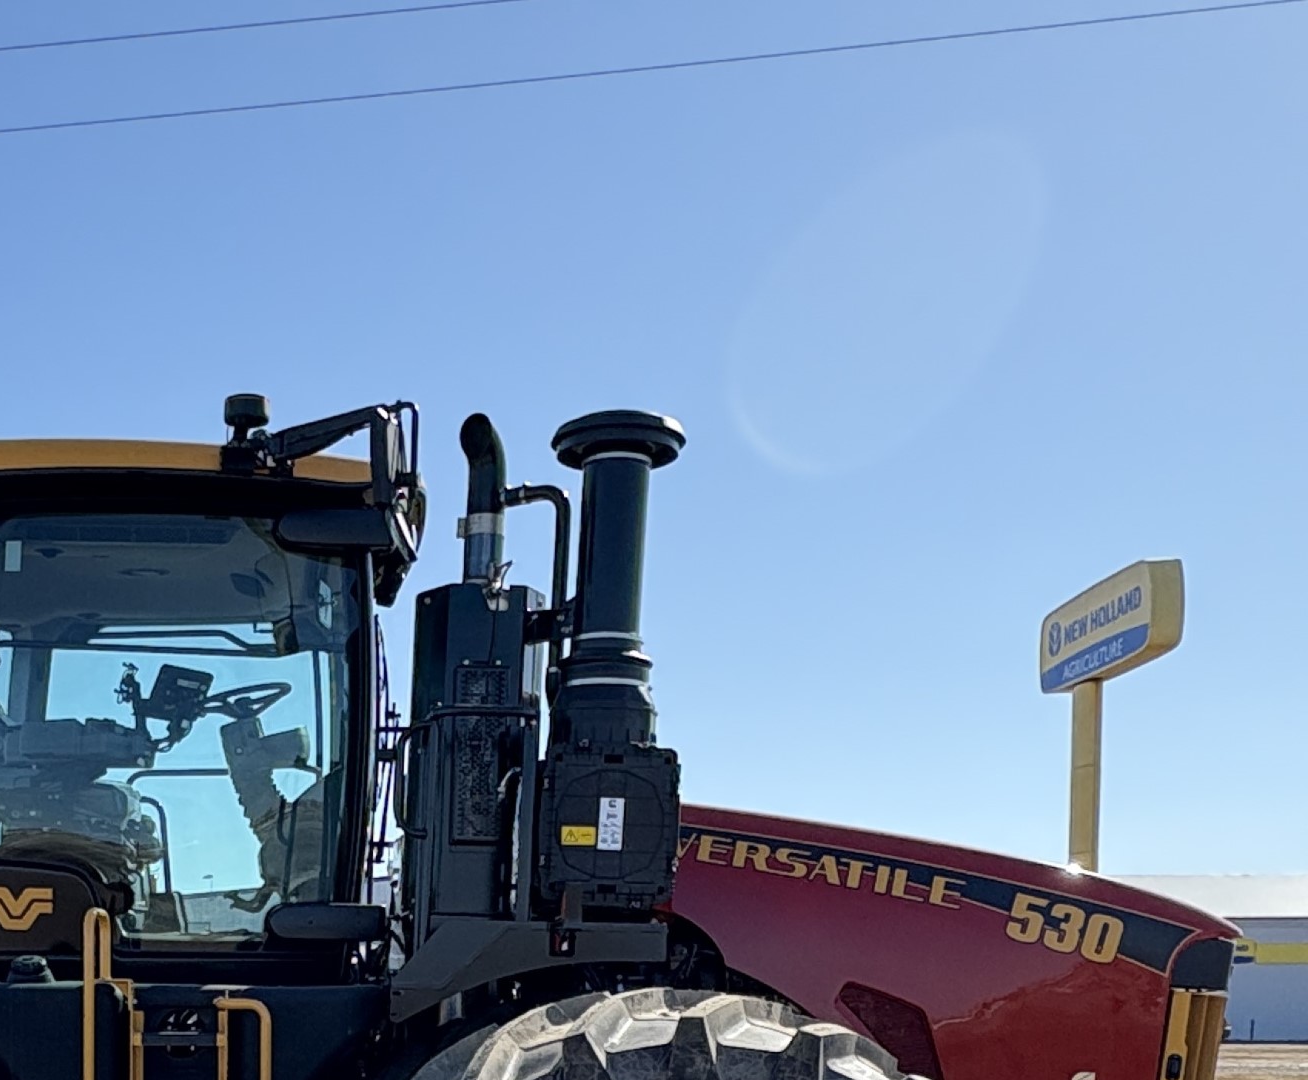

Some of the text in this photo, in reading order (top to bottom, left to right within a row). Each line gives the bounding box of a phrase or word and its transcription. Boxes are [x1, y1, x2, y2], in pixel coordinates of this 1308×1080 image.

[1064, 586, 1142, 646] NEW HOLLAND
[1062, 638, 1123, 681] AGRICULTURE
[1005, 892, 1124, 964] 530
